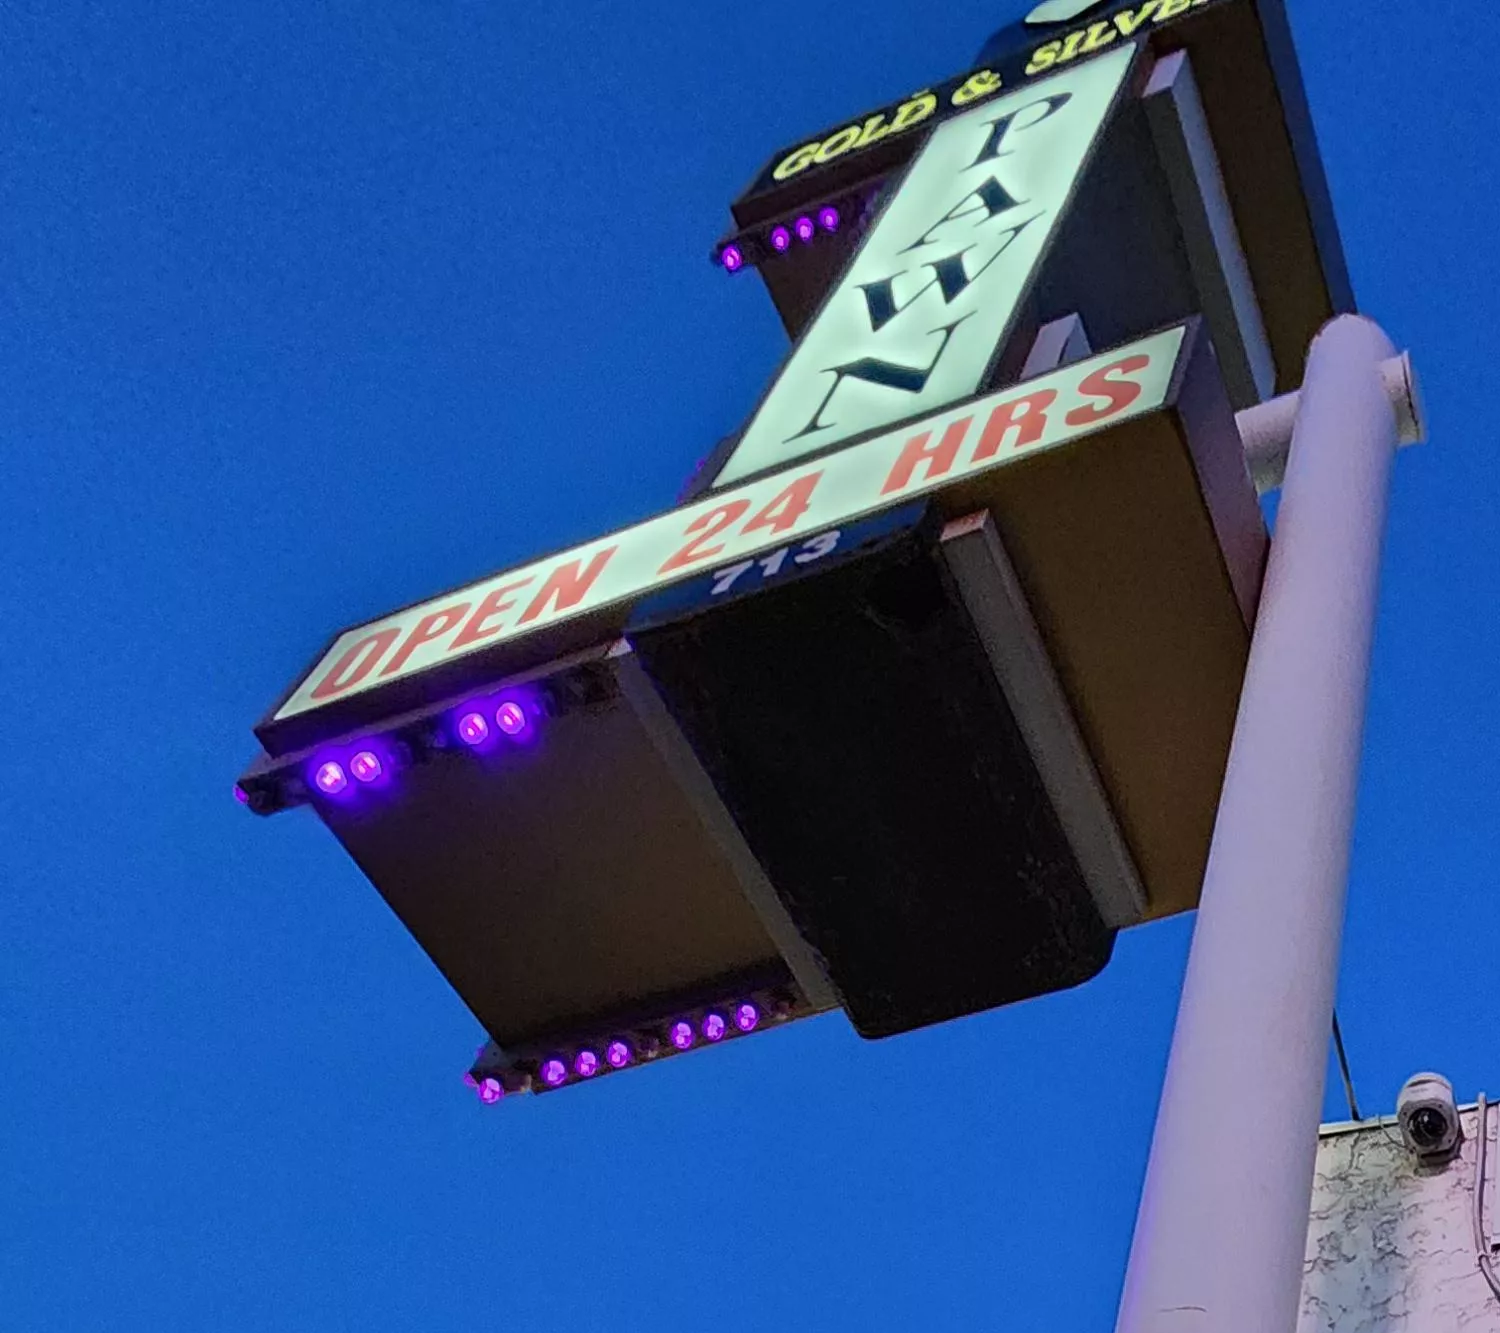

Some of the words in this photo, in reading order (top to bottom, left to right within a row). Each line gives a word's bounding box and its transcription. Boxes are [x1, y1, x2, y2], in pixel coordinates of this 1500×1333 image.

[773, 90, 938, 181] GOLD
[951, 70, 1002, 107] &
[1024, 0, 1208, 75] SILVE
[782, 92, 1073, 444] PAWN
[311, 545, 619, 700] OPEN
[657, 468, 825, 576] 24
[879, 354, 1150, 496] HRS
[710, 530, 841, 595] 713
